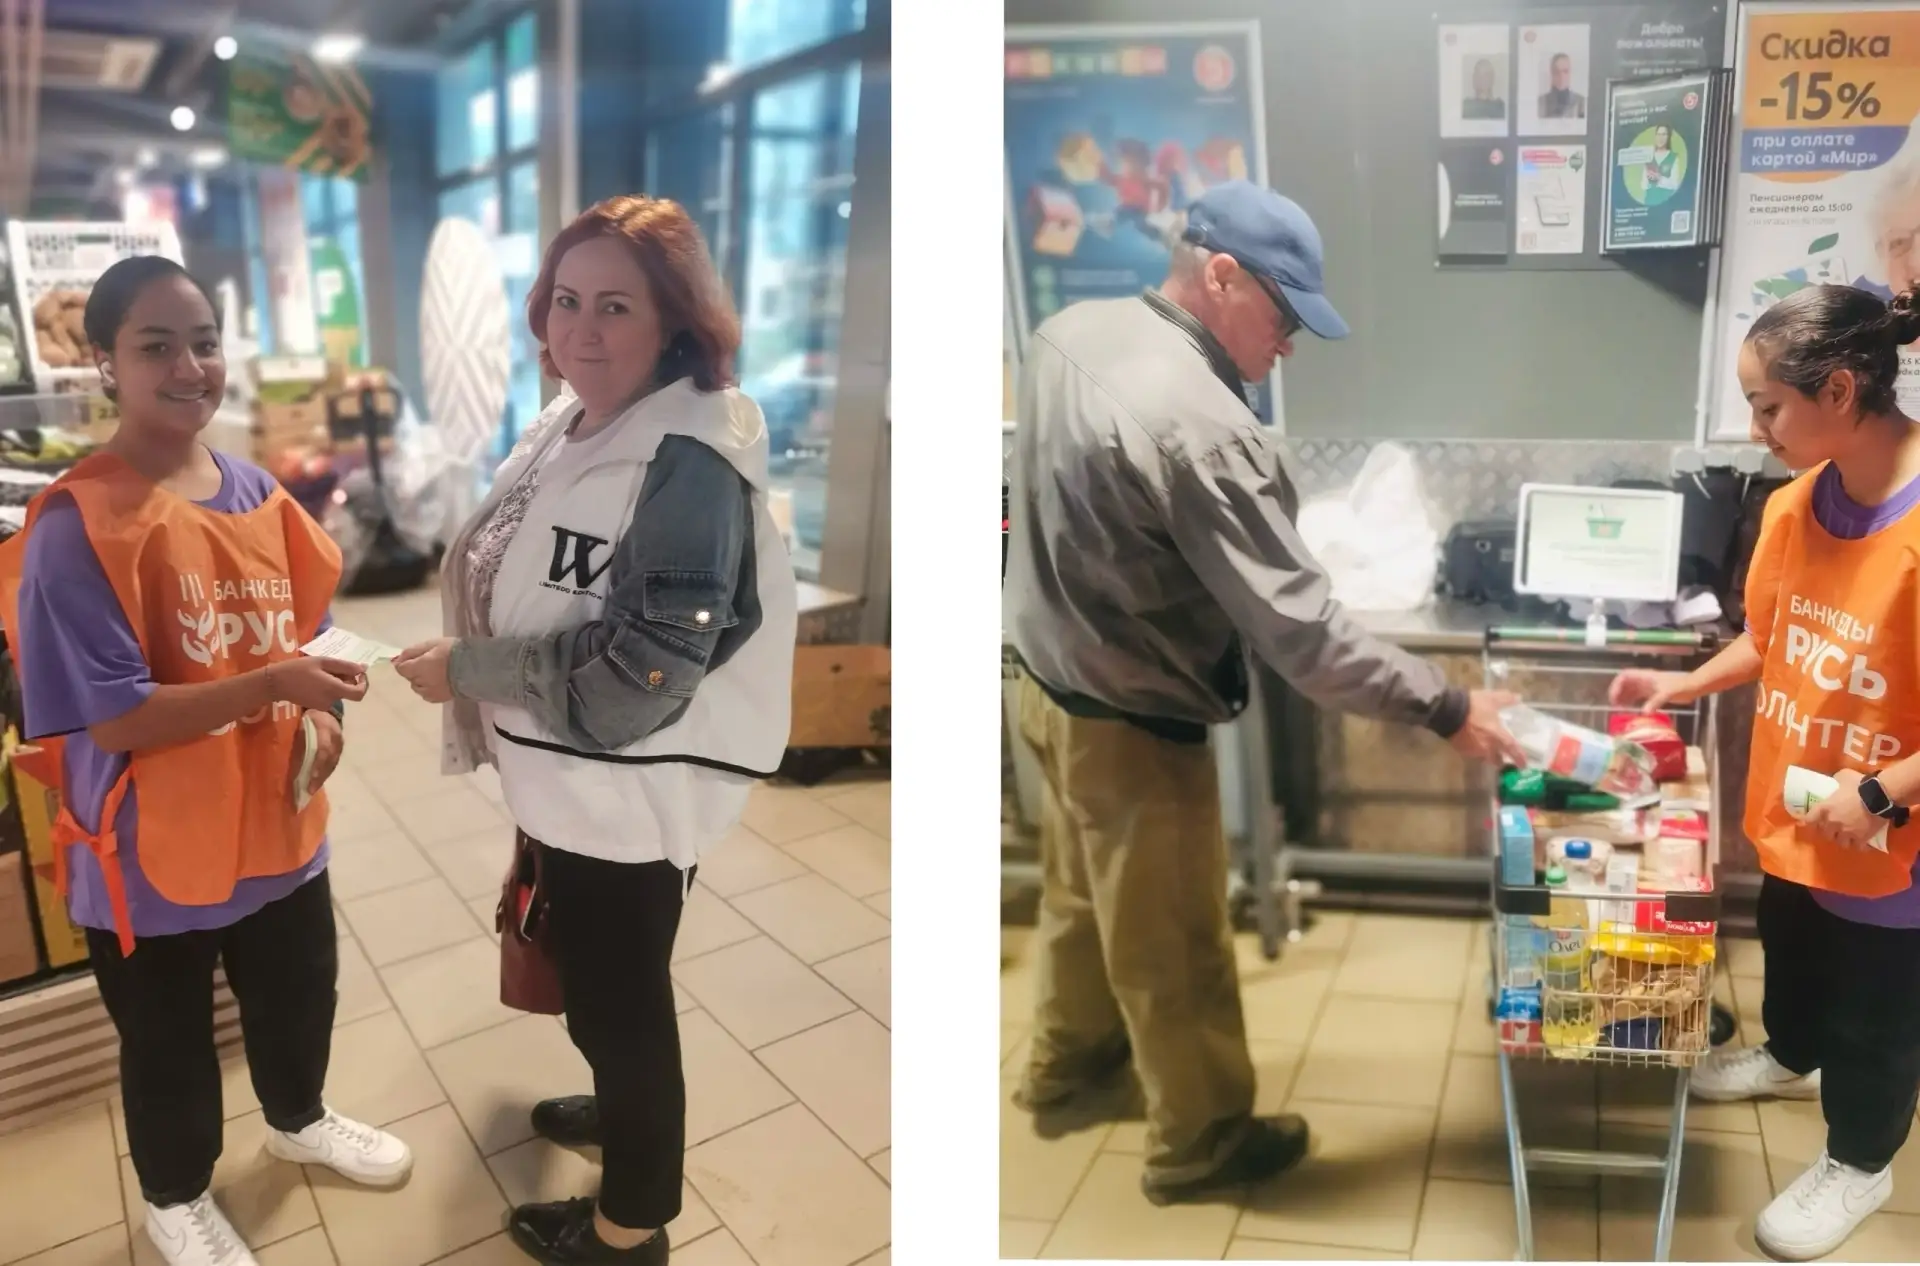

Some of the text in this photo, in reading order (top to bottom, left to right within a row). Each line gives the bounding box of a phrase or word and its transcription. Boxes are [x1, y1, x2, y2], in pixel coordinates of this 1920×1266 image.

[1641, 21, 1684, 36] Добро
[1760, 29, 1891, 61] Скидка
[1760, 71, 1881, 120] -15%
[1752, 134, 1855, 150] при оплате
[1752, 151, 1878, 168] картой «Мир»
[1749, 203, 1853, 214] ежедневно до 15:00
[549, 525, 617, 589] W
[213, 578, 293, 601] БАНК ЕД
[216, 609, 298, 659] РУС
[1785, 623, 1887, 700] РУСЬ
